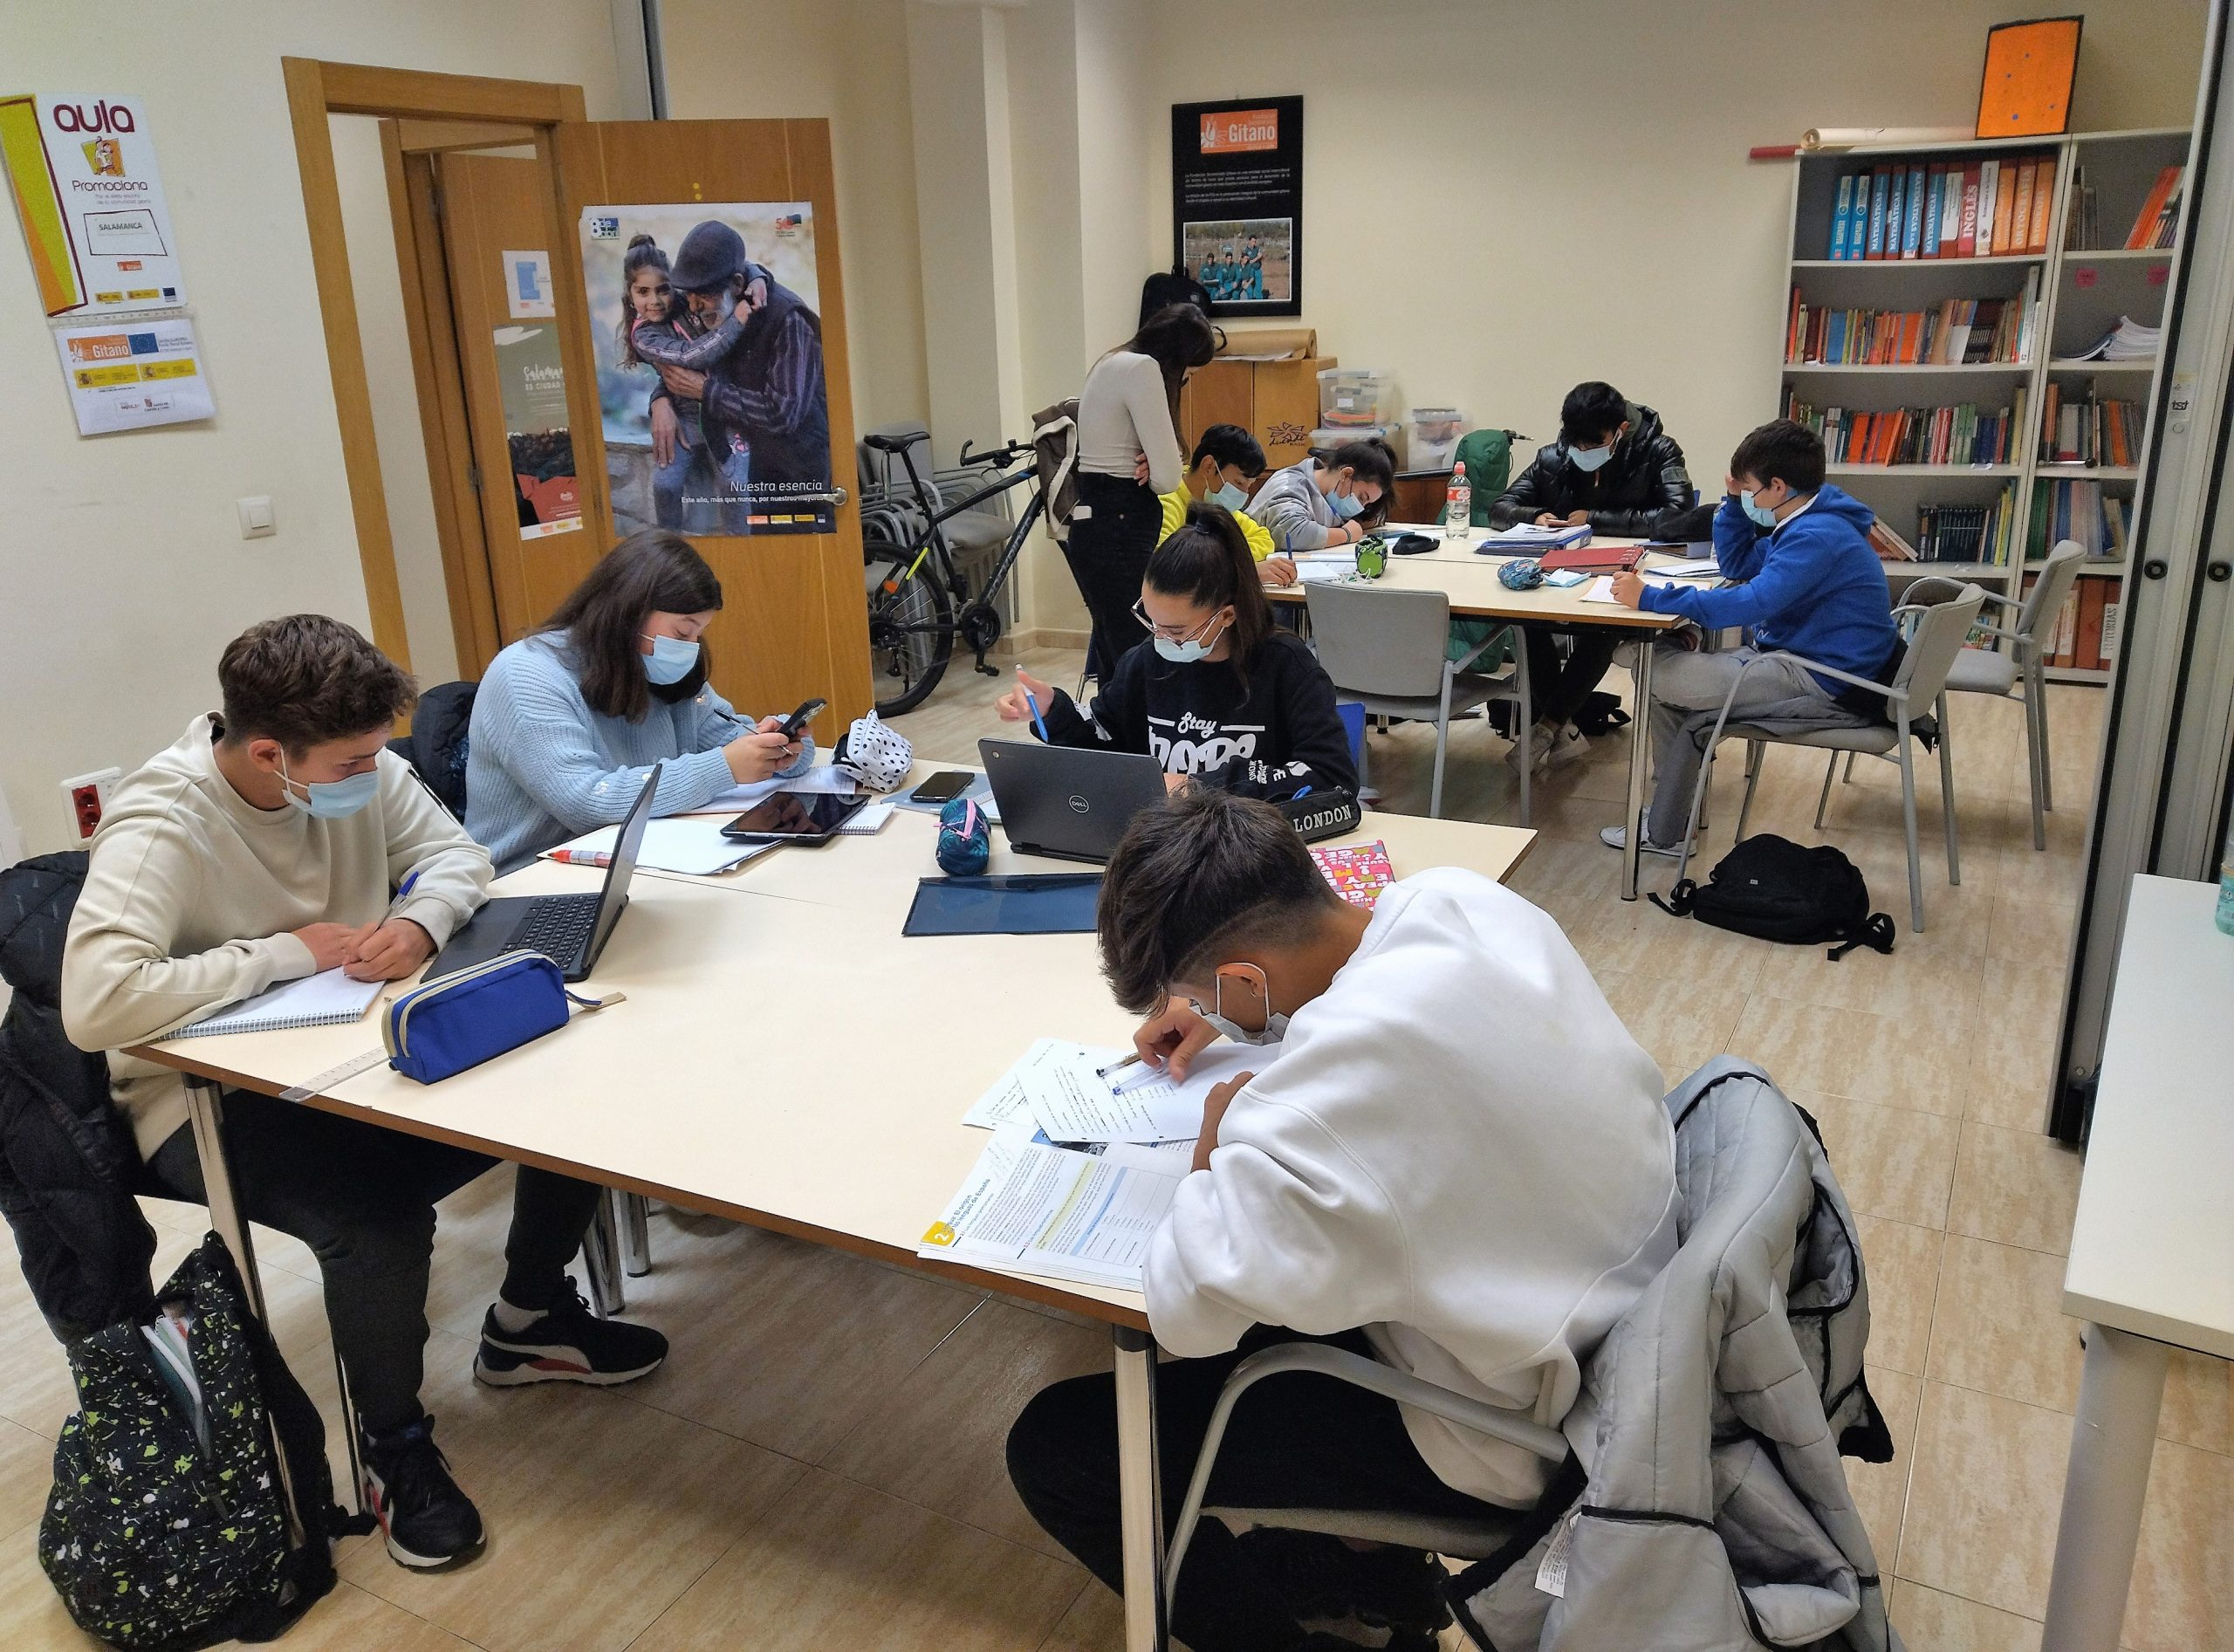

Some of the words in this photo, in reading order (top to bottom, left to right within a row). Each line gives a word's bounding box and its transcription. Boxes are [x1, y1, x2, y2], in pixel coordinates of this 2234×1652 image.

[53, 99, 135, 134] aula
[1229, 124, 1276, 142] Gitano
[1963, 184, 1979, 238] INGLÉS
[99, 222, 143, 231] SALAMANCA
[92, 345, 129, 358] Gitano
[730, 481, 776, 491] Nuestra
[778, 478, 823, 490] esencia
[1177, 711, 1217, 739] Stay
[1072, 799, 1087, 809] DELL
[1292, 805, 1353, 833] LONDON
[934, 1232, 949, 1242] 2
